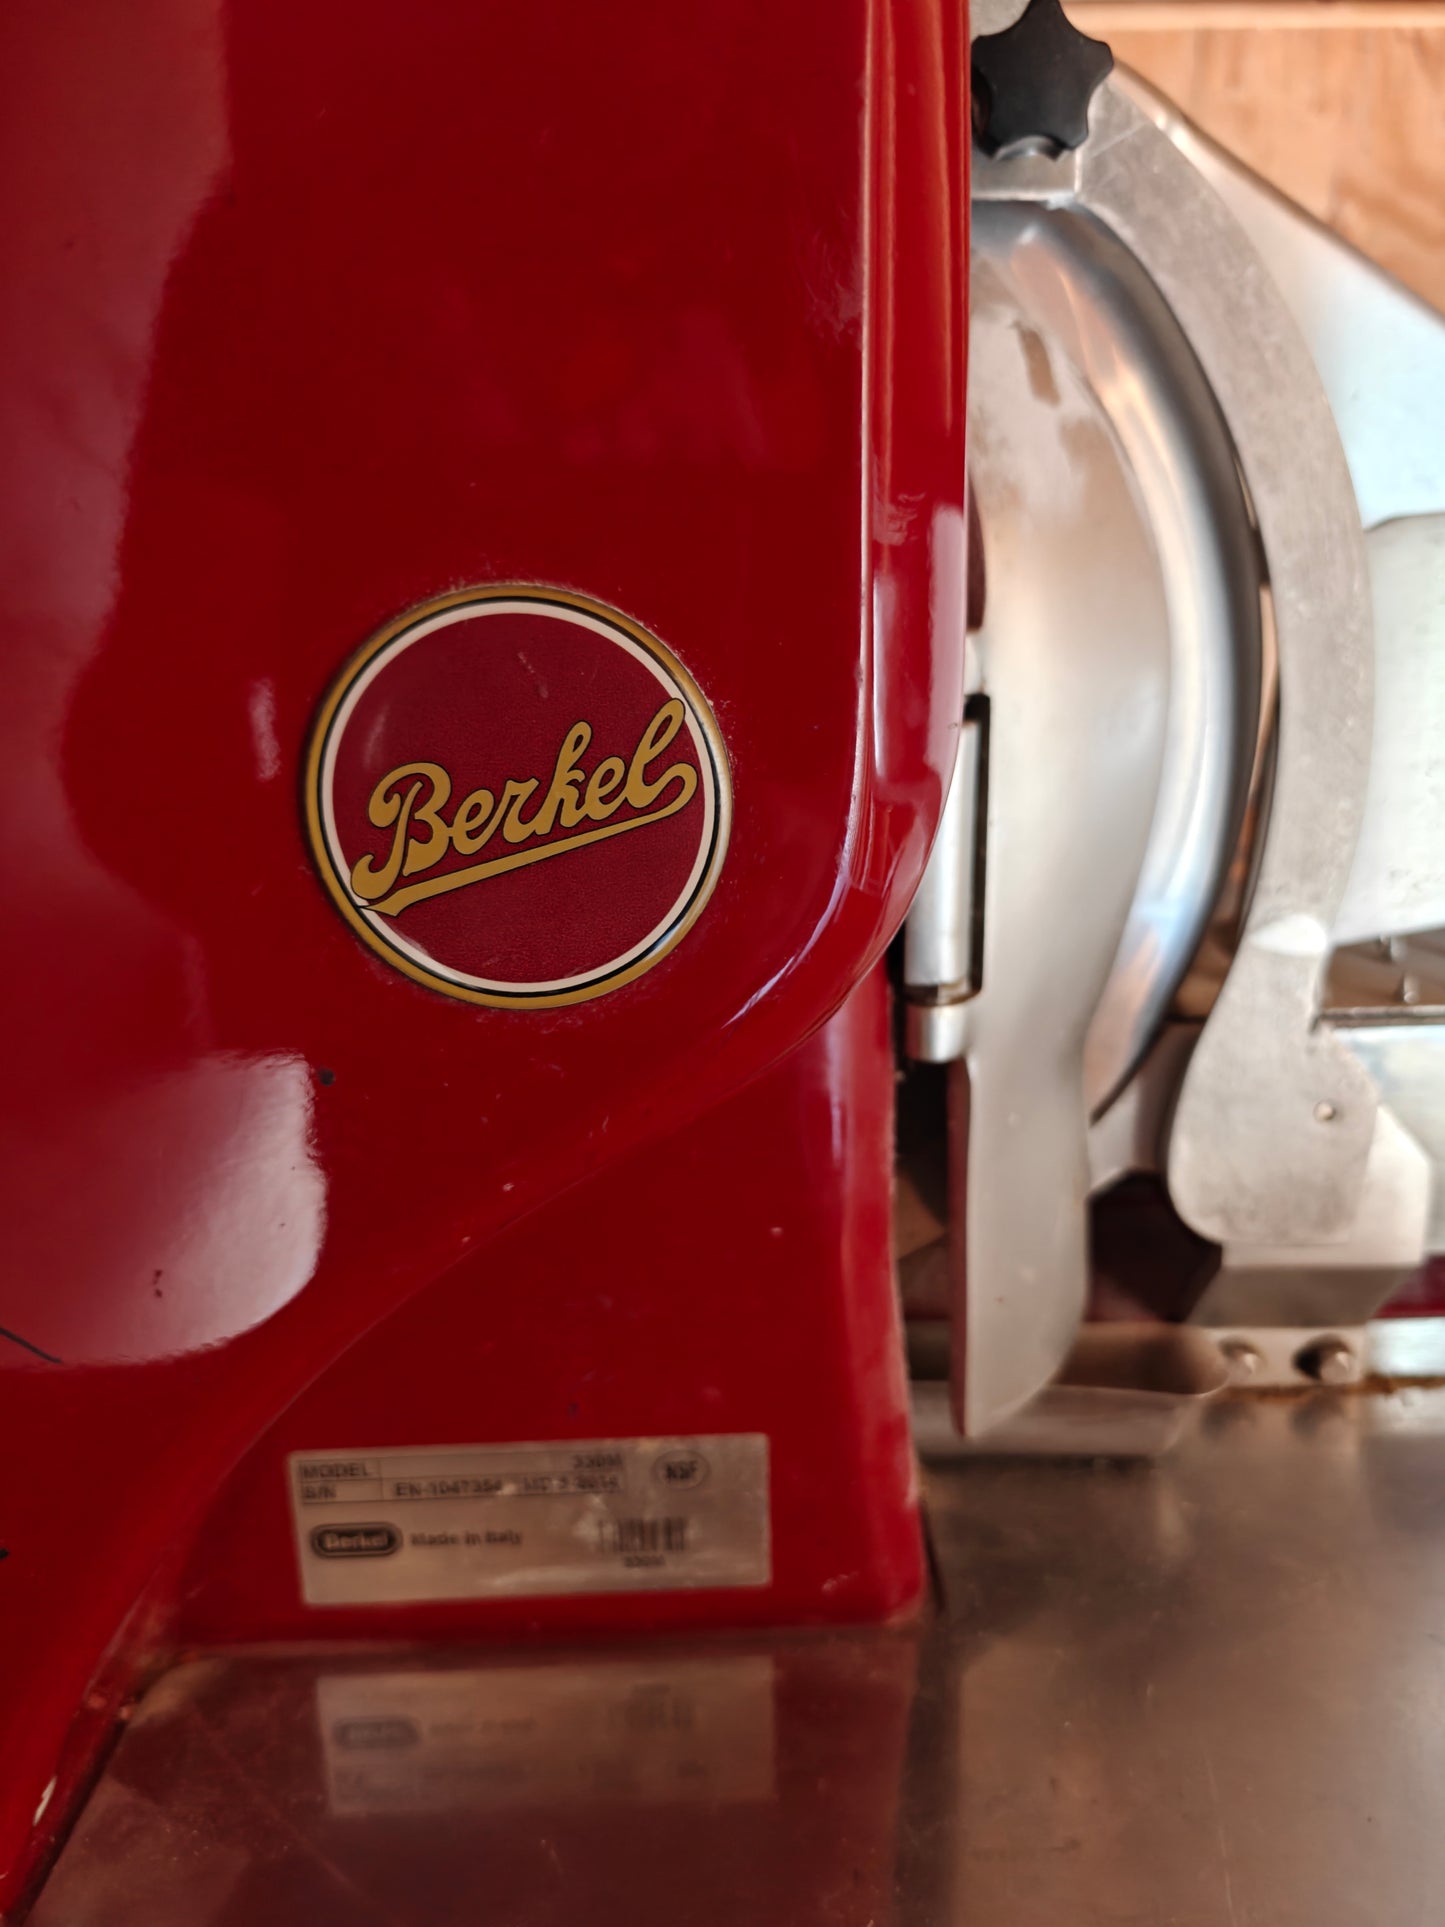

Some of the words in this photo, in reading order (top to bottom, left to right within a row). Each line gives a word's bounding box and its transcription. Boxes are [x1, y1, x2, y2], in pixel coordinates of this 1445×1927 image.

[349, 697, 699, 914] Berkel
[303, 1461, 368, 1479] MODEL
[303, 1483, 337, 1499] S/N
[410, 1531, 457, 1546] Made
[463, 1530, 481, 1545] in
[485, 1528, 522, 1546] Italy
